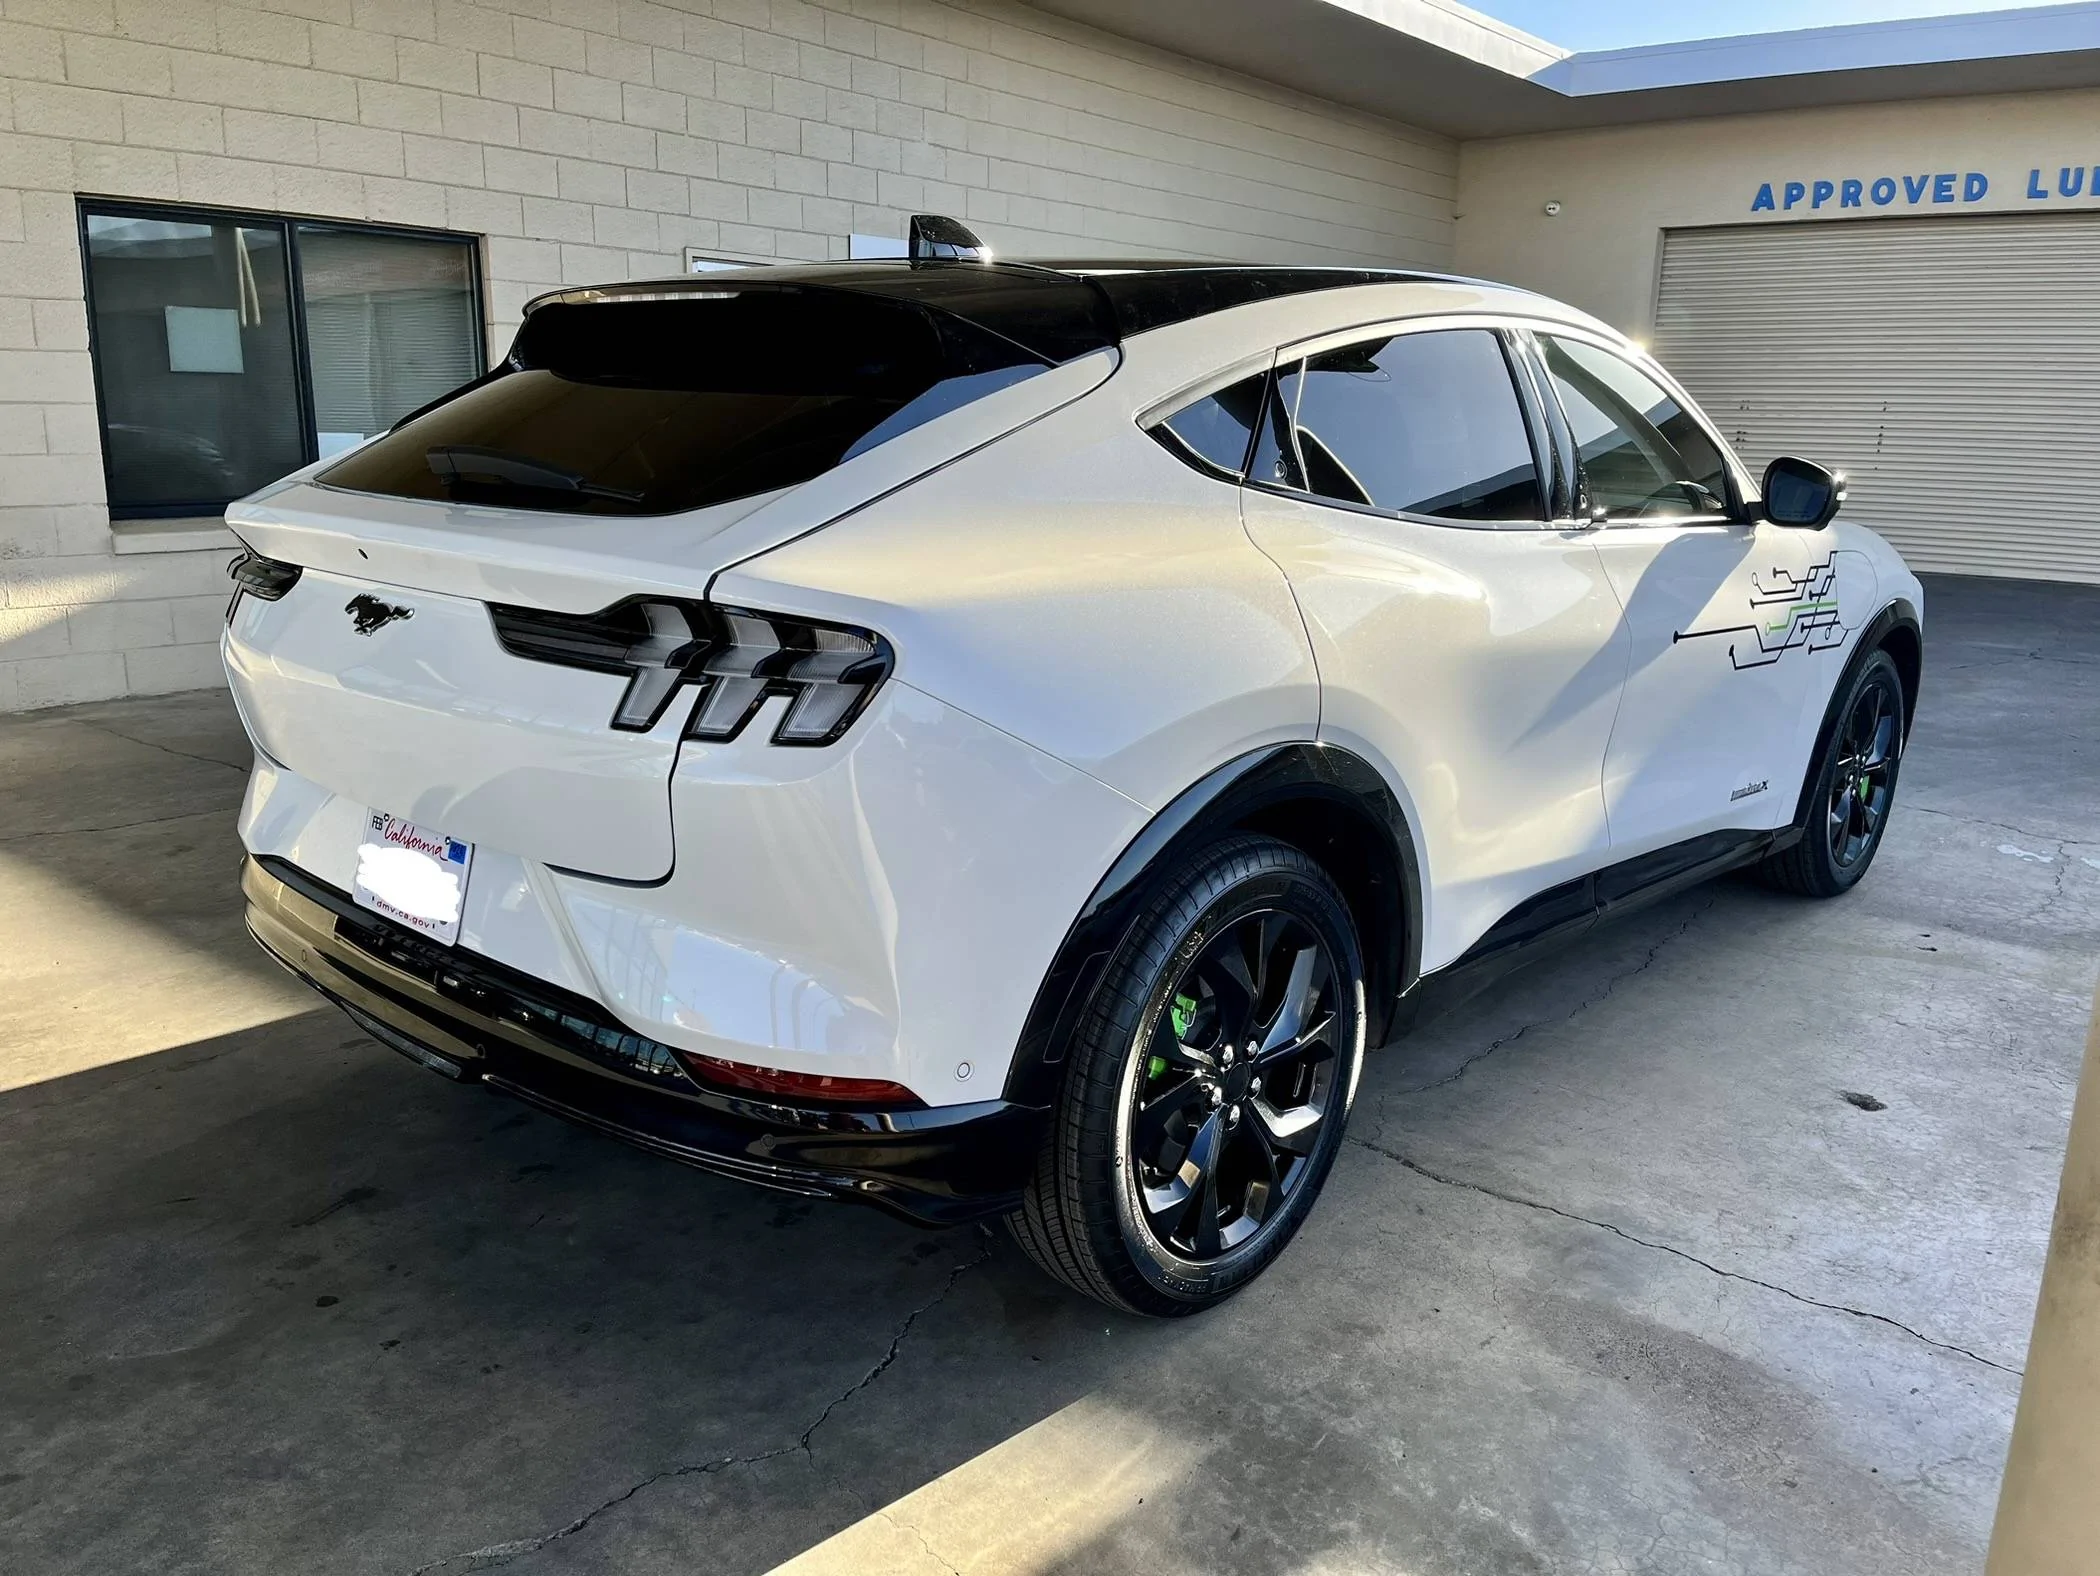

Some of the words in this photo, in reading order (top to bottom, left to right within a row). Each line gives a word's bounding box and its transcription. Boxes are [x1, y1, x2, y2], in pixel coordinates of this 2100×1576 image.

[1751, 173, 1988, 211] APPROVED
[372, 815, 383, 831] FEB
[384, 818, 448, 861] California
[376, 900, 430, 928] dmv.ca.gov
